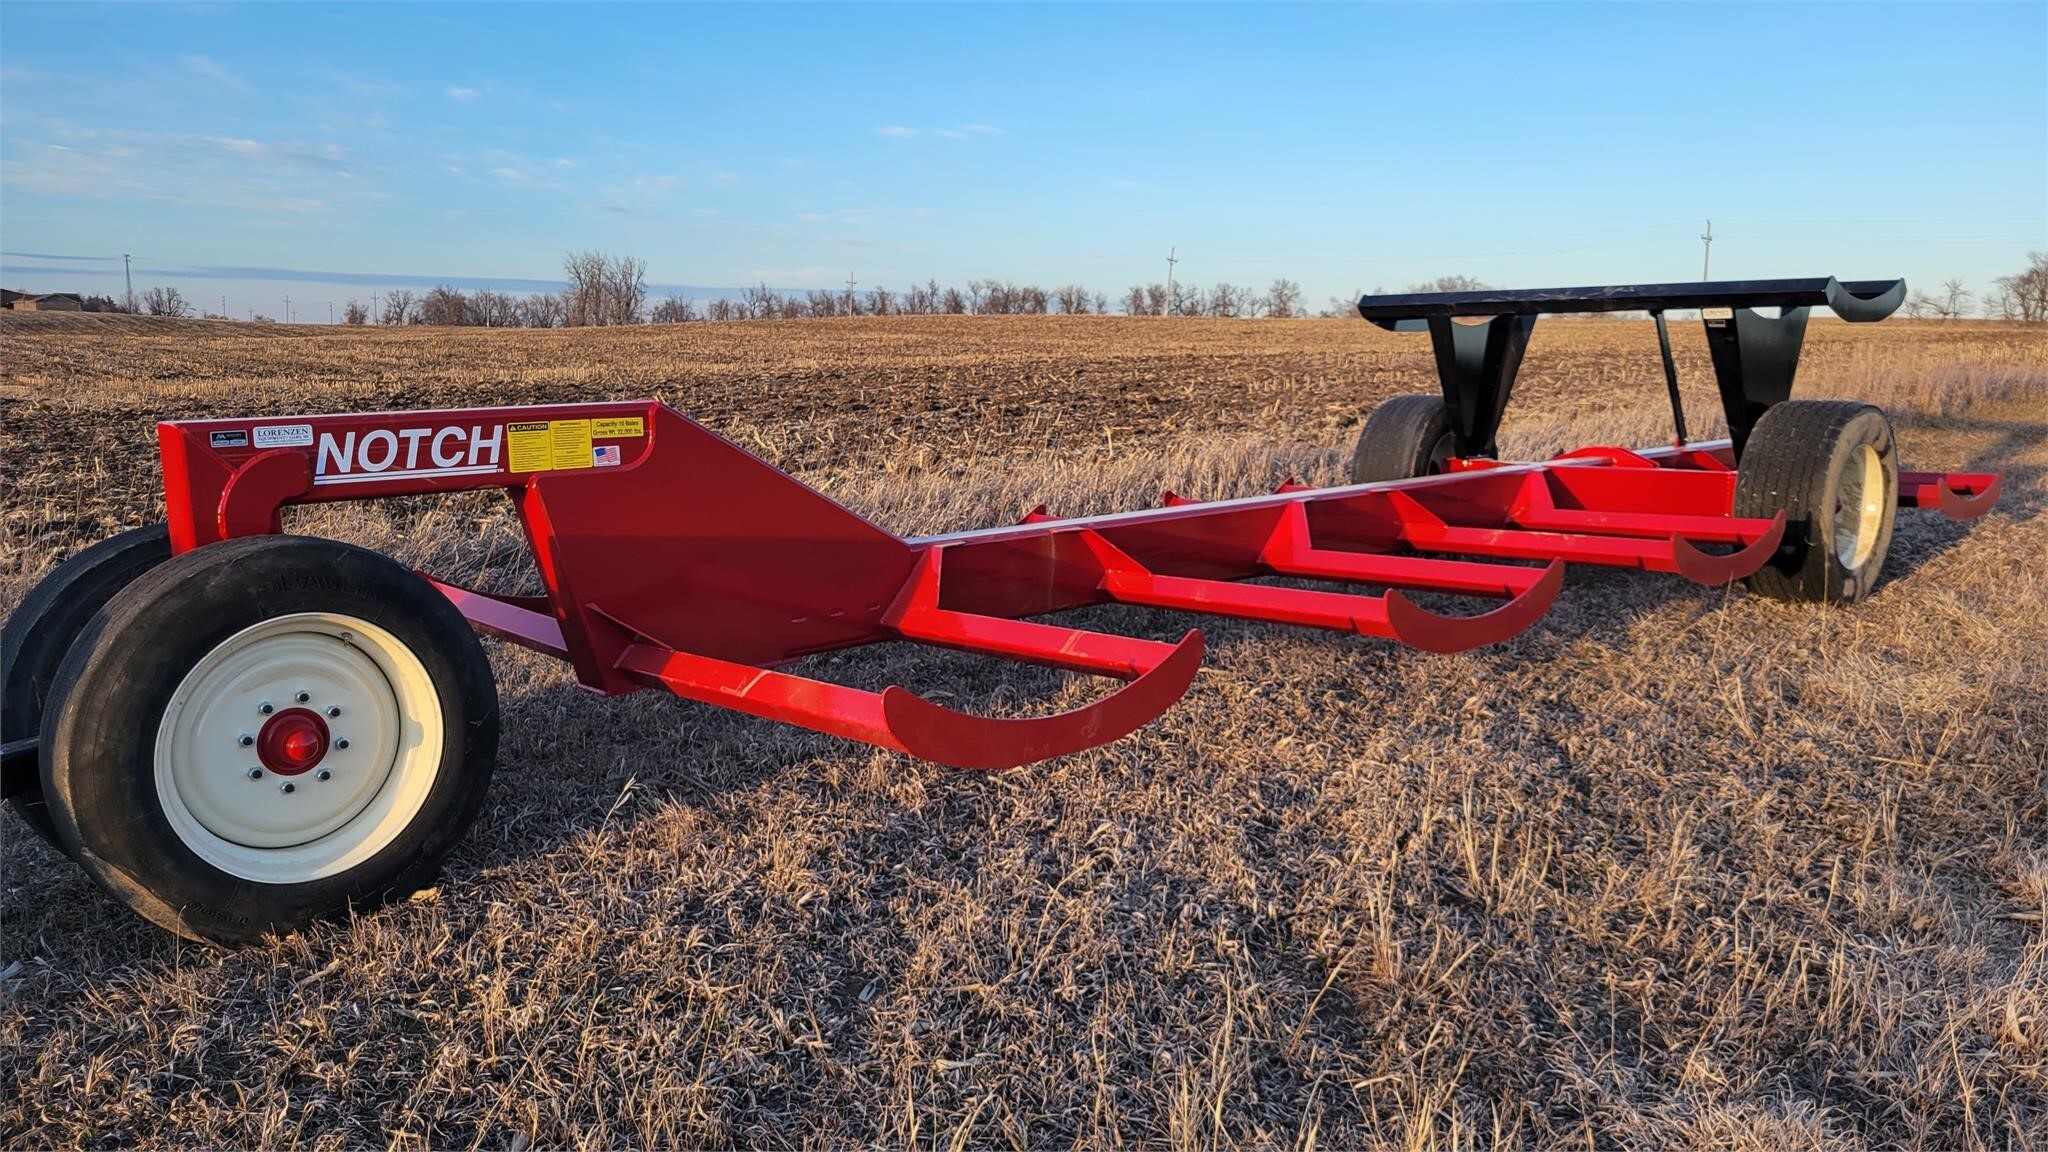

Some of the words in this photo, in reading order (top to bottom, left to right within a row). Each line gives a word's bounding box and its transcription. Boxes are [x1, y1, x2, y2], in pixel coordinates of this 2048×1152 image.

[516, 423, 547, 431] CAUTION
[258, 428, 308, 437] LORENZEN
[316, 425, 502, 474] NOTCH
